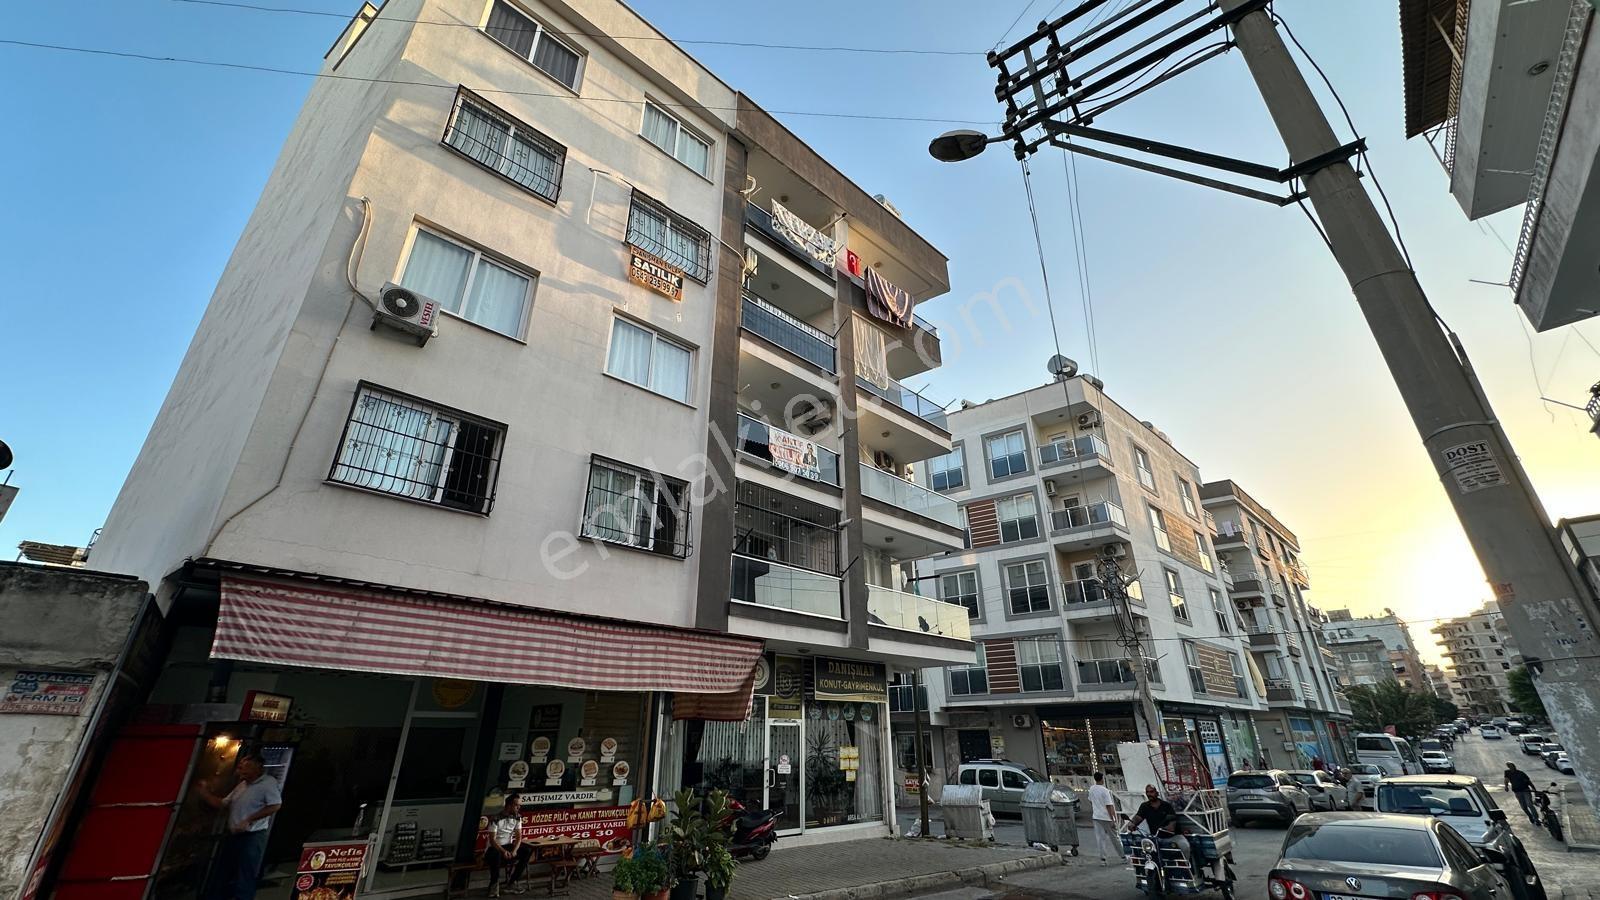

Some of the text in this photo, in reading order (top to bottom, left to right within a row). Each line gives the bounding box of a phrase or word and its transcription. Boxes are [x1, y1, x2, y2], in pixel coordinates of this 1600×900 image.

[633, 257, 680, 287] SATILIK
[662, 282, 670, 293] 99
[420, 302, 434, 325] VESTEL
[1446, 443, 1486, 460] DOST
[828, 661, 874, 679] DANIŞMAN
[577, 810, 596, 820] KANAT
[572, 831, 590, 839] 26
[595, 829, 614, 837] 30
[328, 848, 363, 857] Nefis
